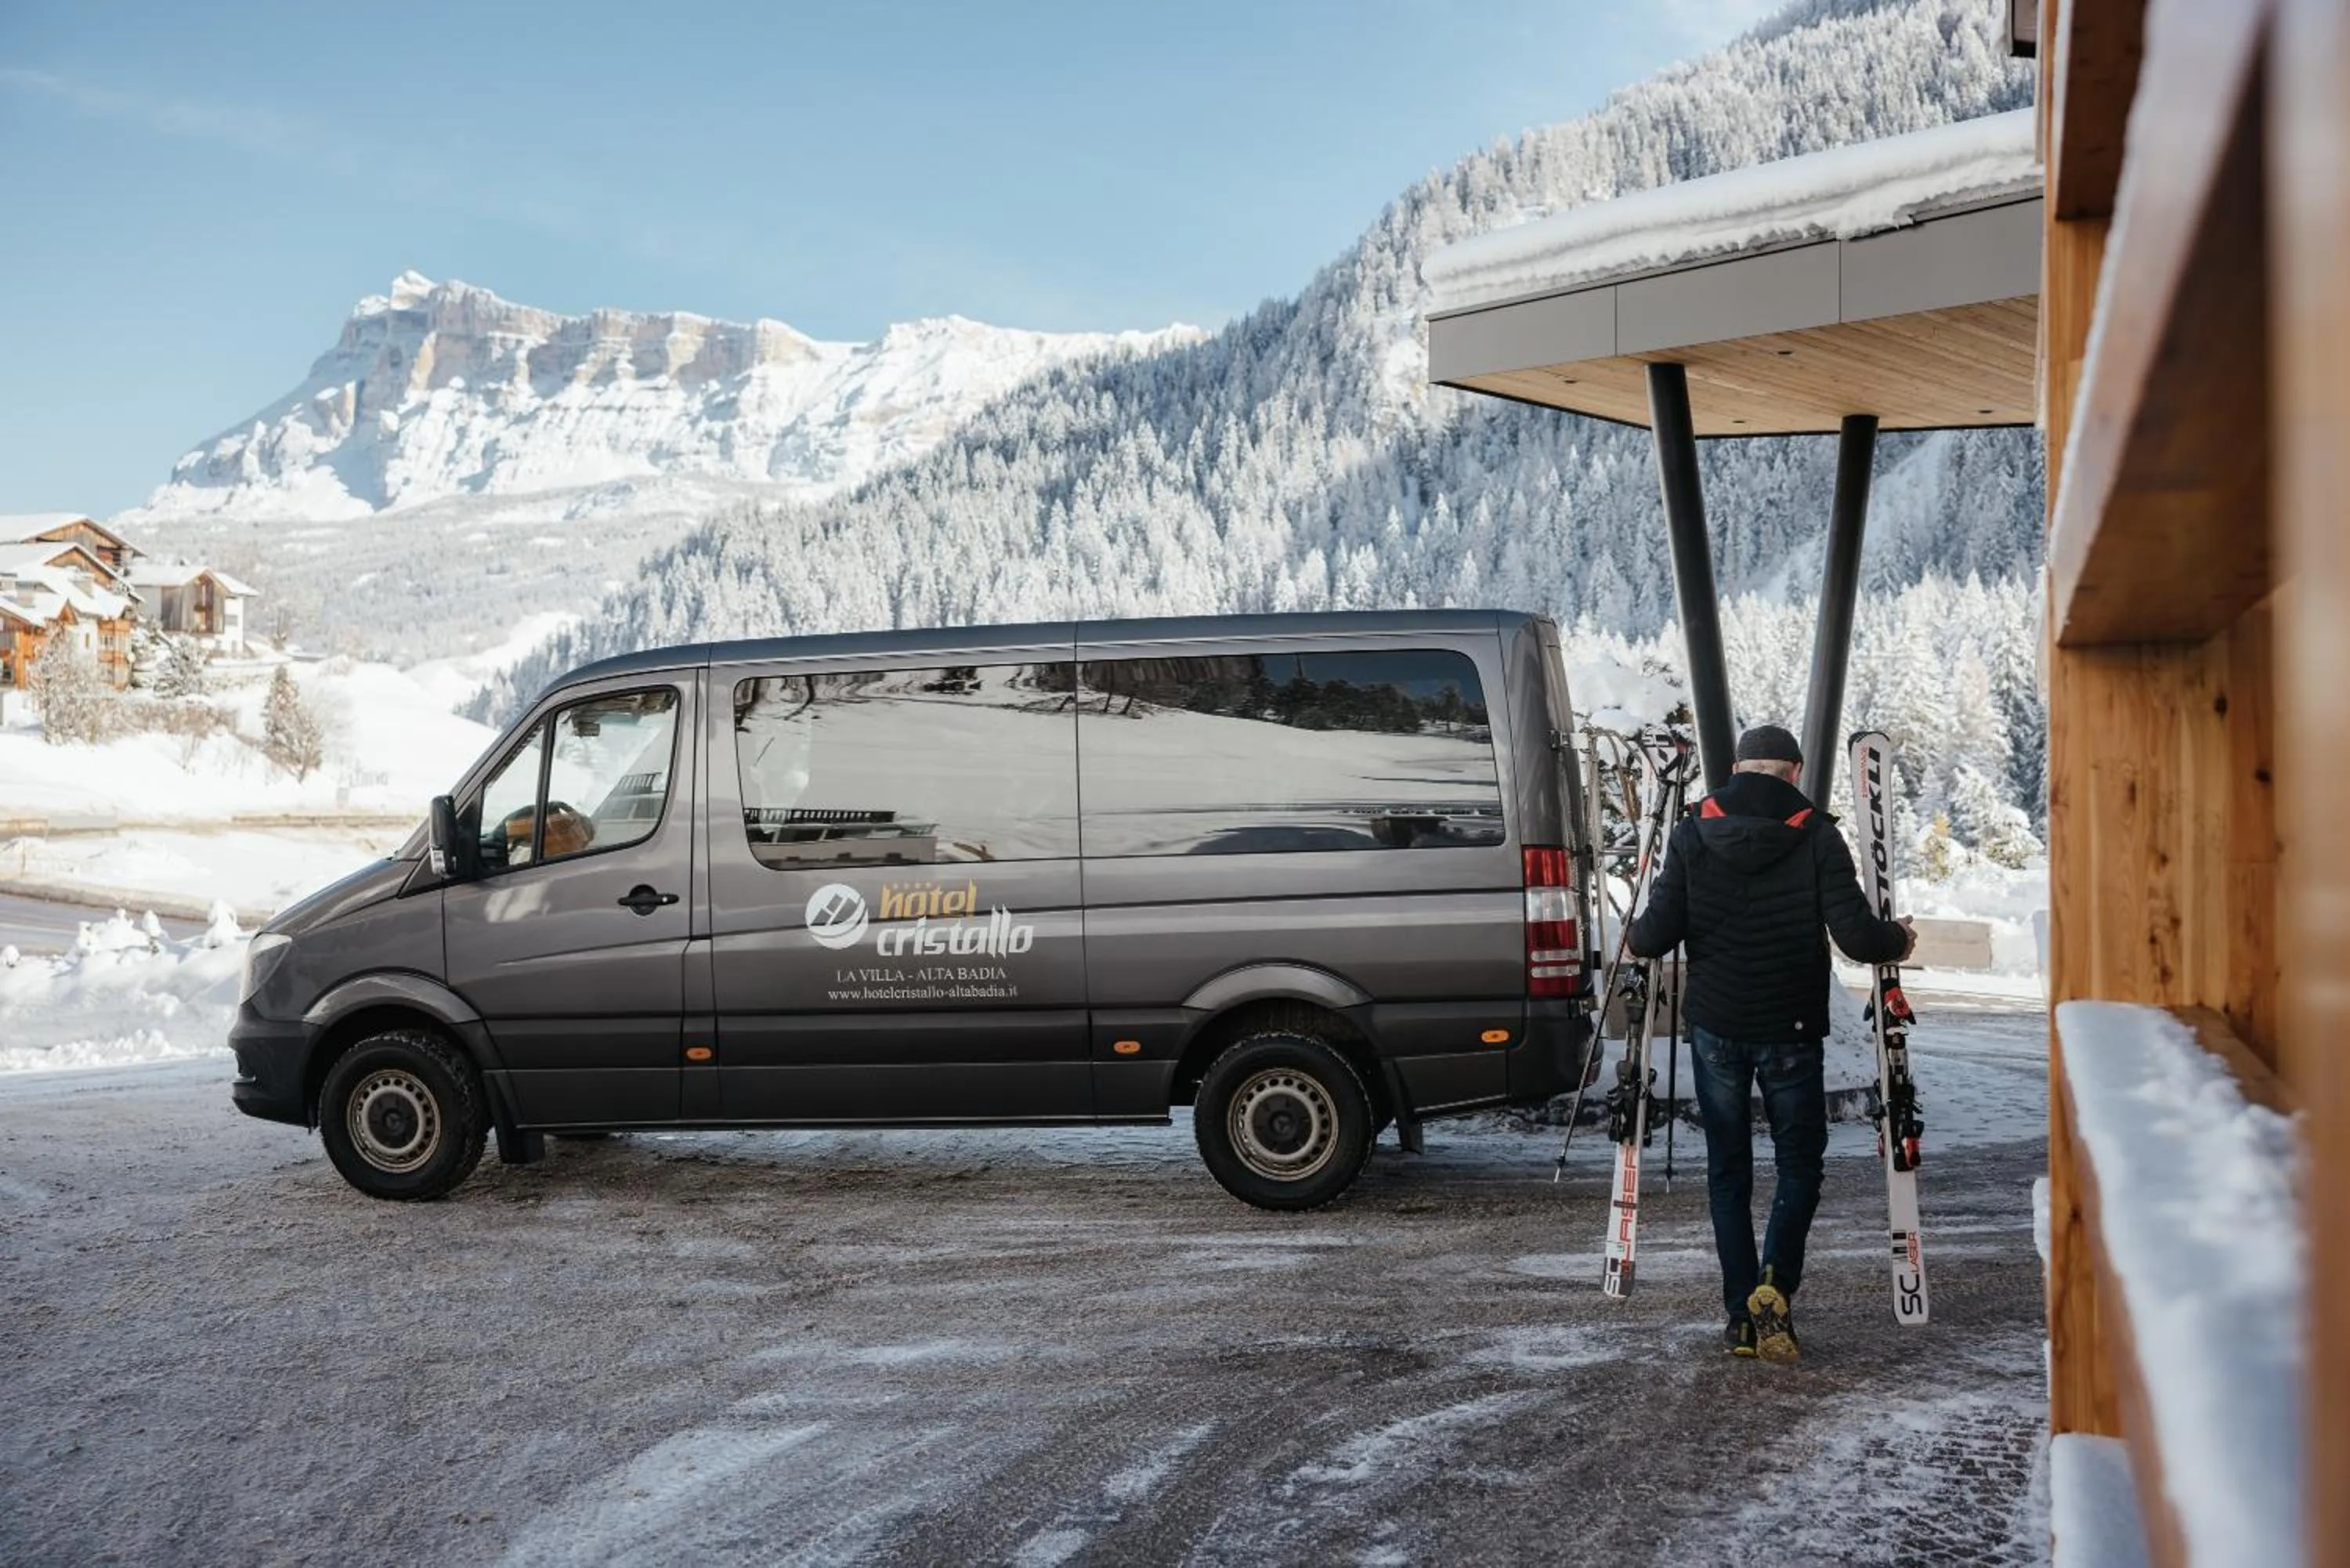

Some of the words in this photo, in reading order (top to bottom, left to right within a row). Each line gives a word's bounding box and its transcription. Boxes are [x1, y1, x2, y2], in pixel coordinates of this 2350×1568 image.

[1867, 746, 1891, 922] STÖCKLI
[879, 878, 978, 923] hotel
[877, 903, 1035, 959] cristallo
[828, 984, 1018, 1000] www.hotelcristallo-altabadia.it
[837, 969, 856, 983] LA
[859, 967, 905, 981] VILLA
[916, 967, 955, 981] ALTA
[957, 966, 1007, 981] BADIA
[1907, 1230, 1920, 1273] LASER
[1899, 1274, 1923, 1316] SC
